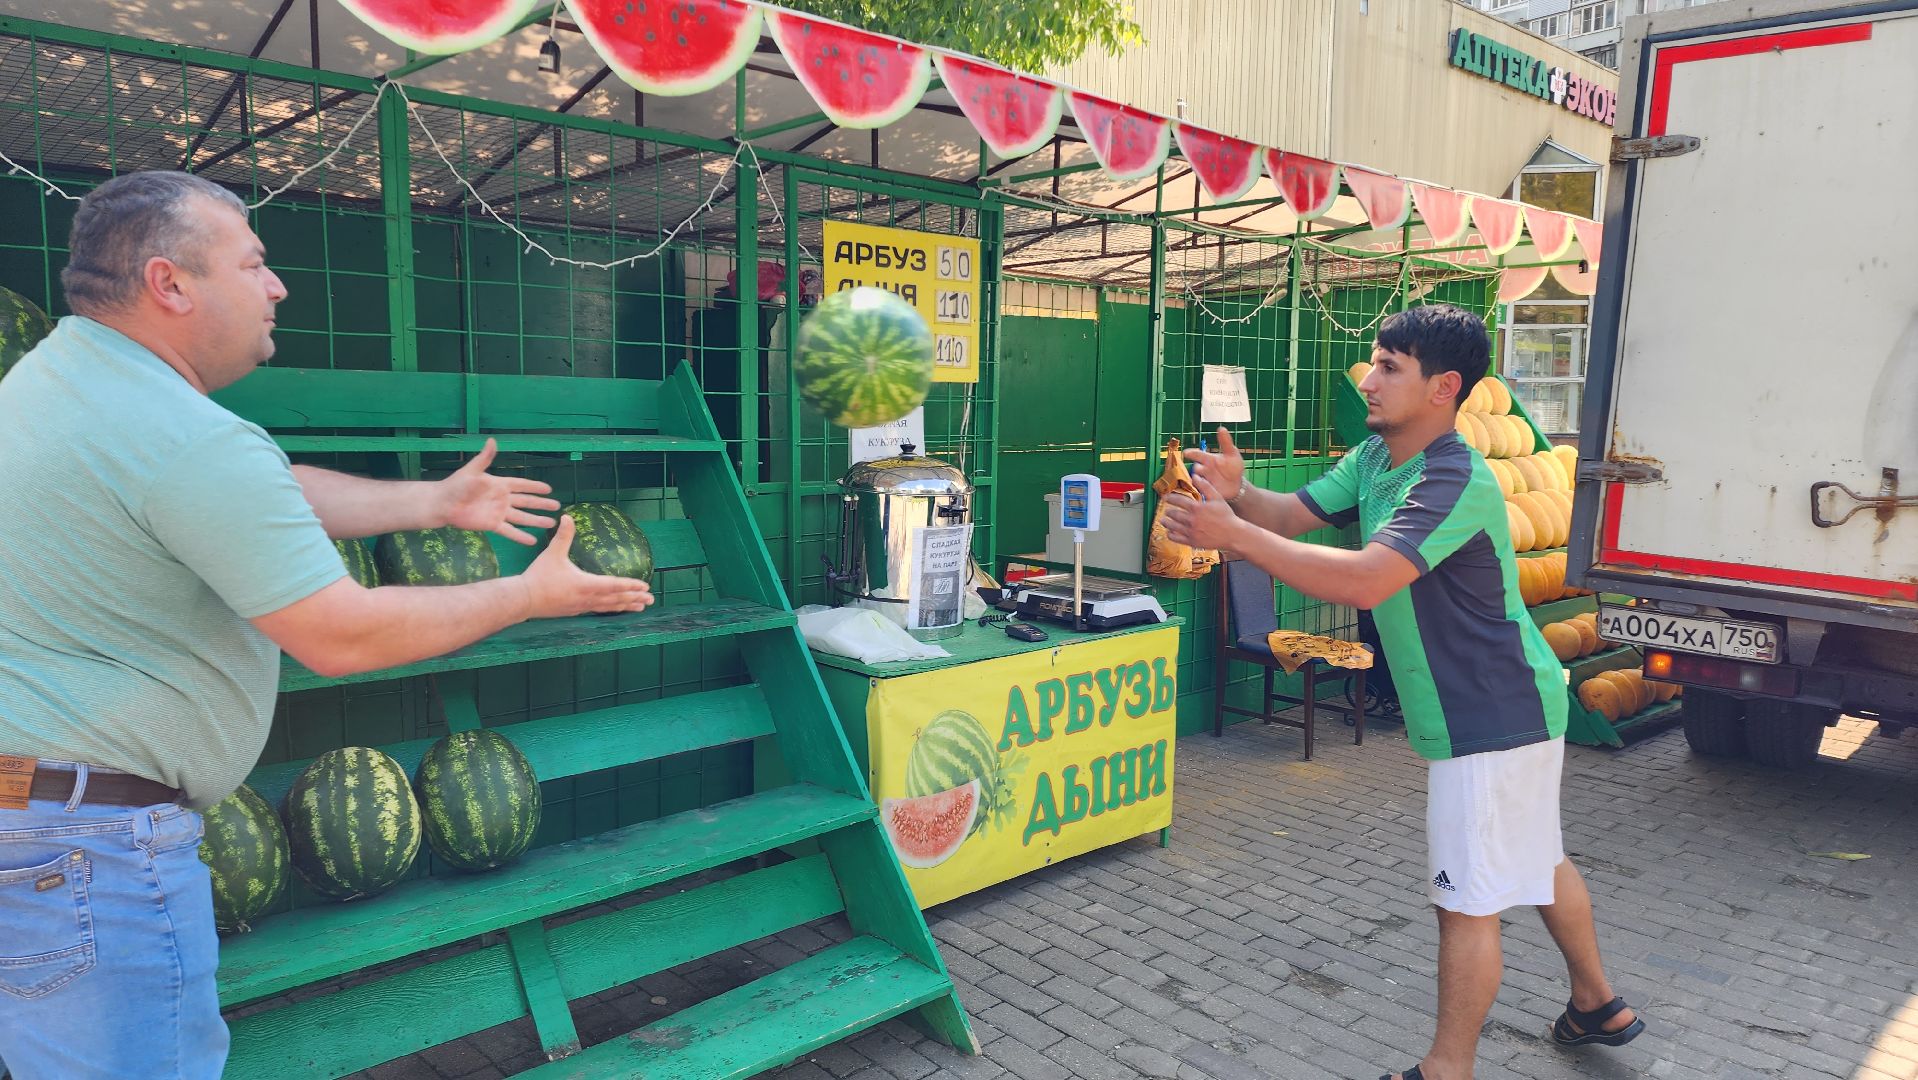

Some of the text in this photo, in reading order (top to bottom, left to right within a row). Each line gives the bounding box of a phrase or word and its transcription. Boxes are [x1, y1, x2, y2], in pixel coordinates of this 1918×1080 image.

[1453, 27, 1550, 101] АПТЕКА
[834, 240, 970, 278] АРБУЗ 50
[938, 291, 969, 320] 110
[931, 539, 961, 549] СЛАДКАЯ
[1609, 614, 1769, 650] А004ХА 750
[1733, 646, 1756, 656] RUS
[1022, 739, 1168, 847] ДЫНИ
